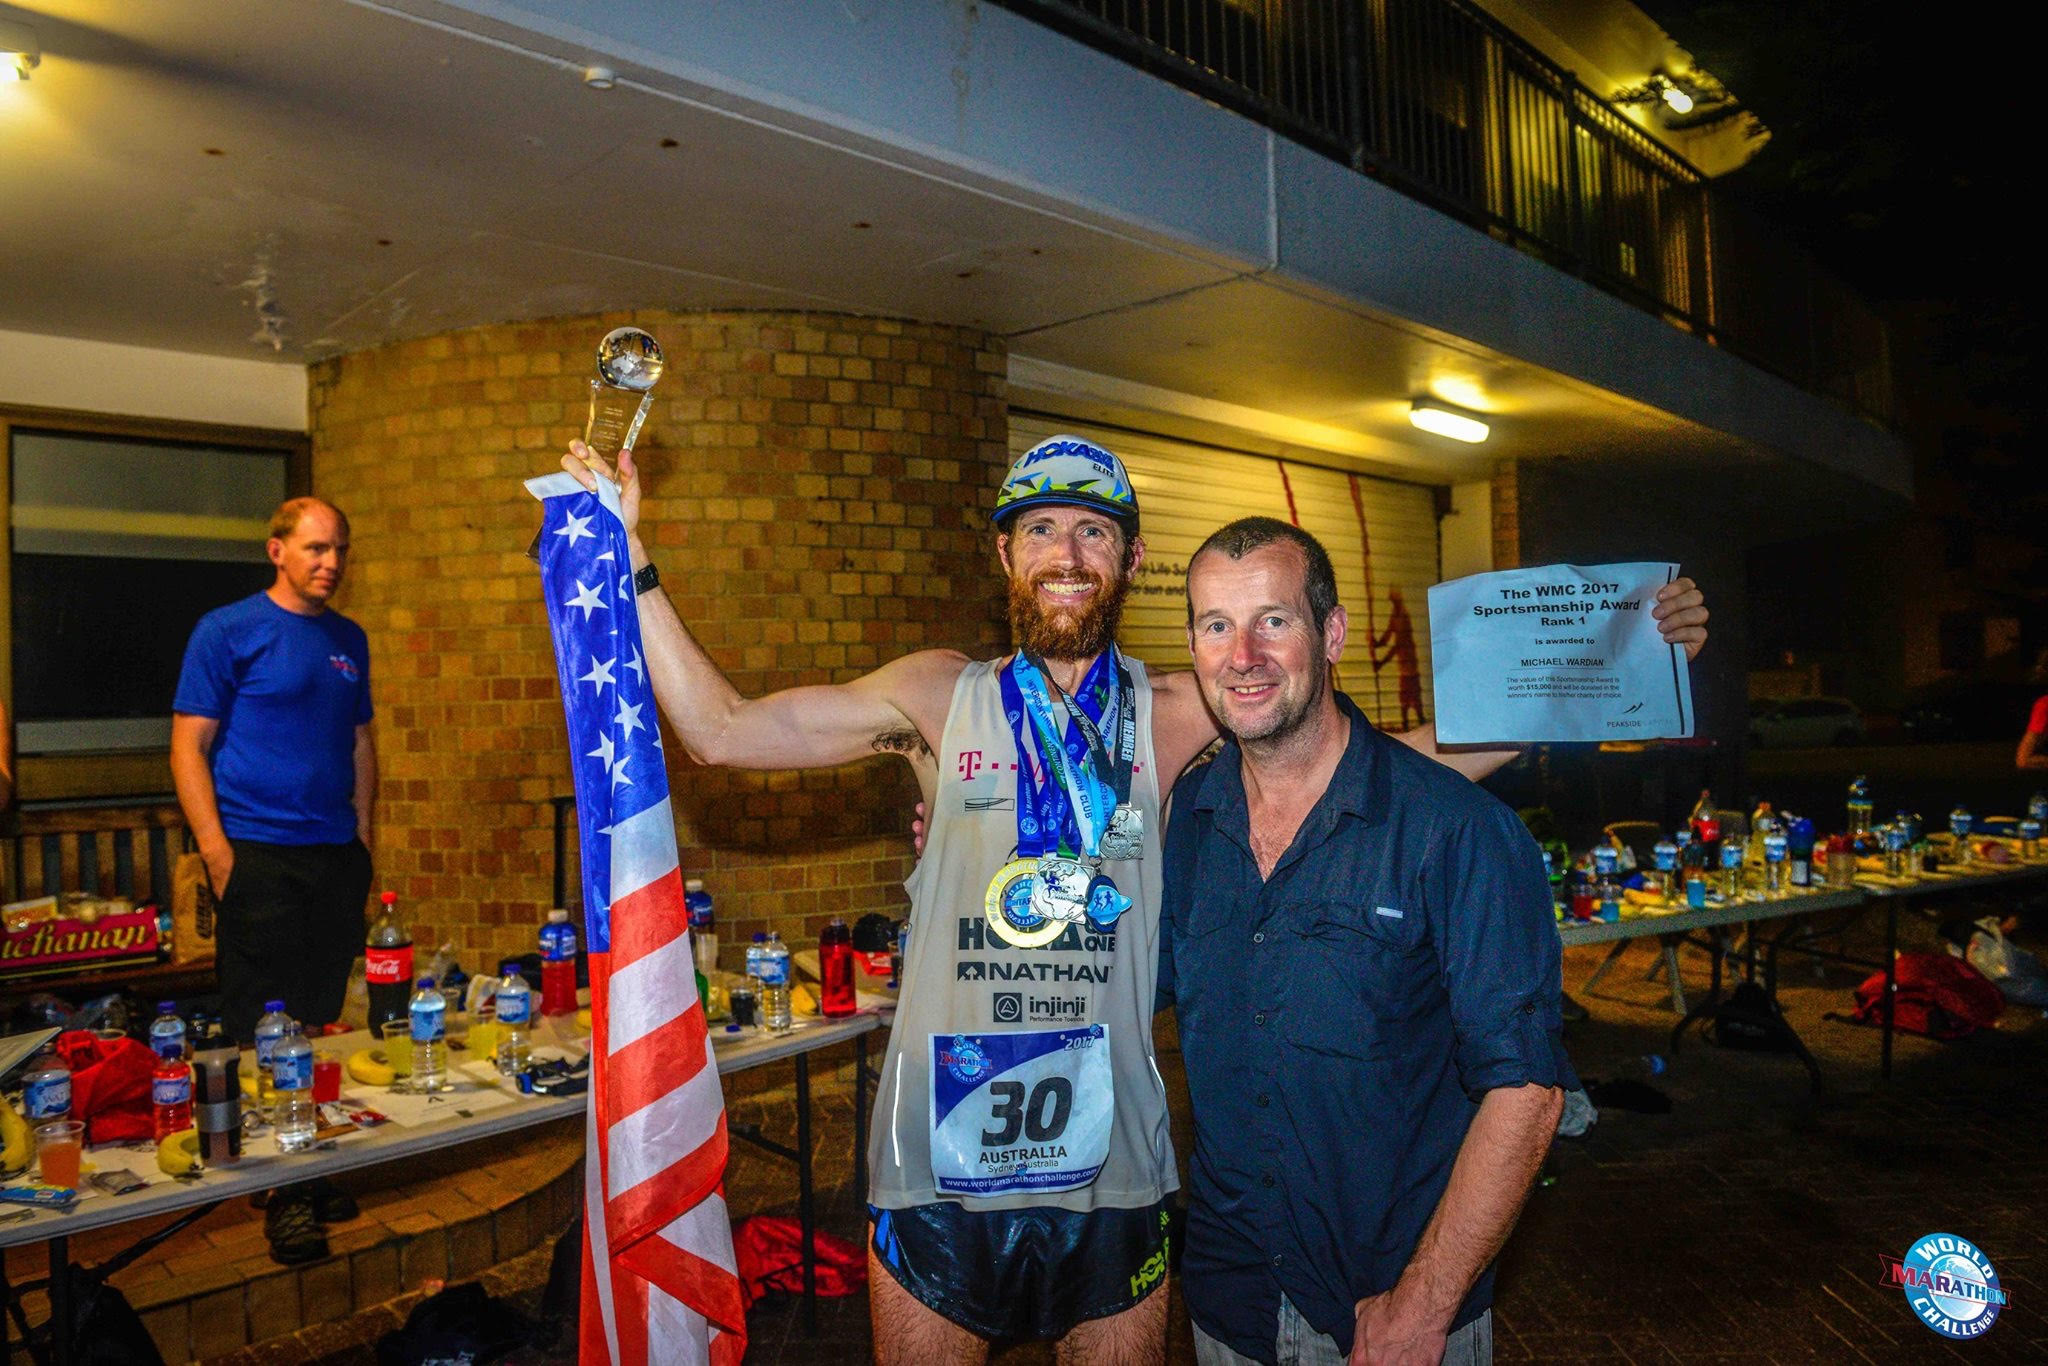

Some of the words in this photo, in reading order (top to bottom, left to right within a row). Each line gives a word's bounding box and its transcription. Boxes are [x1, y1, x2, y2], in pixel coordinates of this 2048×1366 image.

[1093, 463, 1115, 478] ELITE
[1501, 589, 1531, 600] The
[1536, 584, 1576, 597] WMC
[1582, 583, 1619, 594] 2017
[1474, 601, 1594, 618] Sportsmanship
[1600, 599, 1641, 611] Award
[1541, 617, 1575, 626] Rank
[1579, 617, 1586, 625] 1
[1521, 658, 1563, 667] MICHAEL
[1566, 658, 1604, 666] WARDIAN
[1102, 705, 1118, 740] ARATHON
[1607, 720, 1641, 728] PEAKSIDE
[1121, 720, 1136, 763] MEMBER
[1067, 756, 1086, 792] ARATHON
[1079, 795, 1094, 819] CLUB
[958, 917, 1084, 951] HOA
[989, 962, 1109, 984] NATHAN
[1030, 996, 1086, 1017] injinji
[1064, 1035, 1096, 1051] 2017
[981, 1076, 1073, 1148] 30
[979, 1146, 1068, 1164] AUSTRALIA
[945, 1168, 1098, 1189] www.worldmarathonchallenge.com
